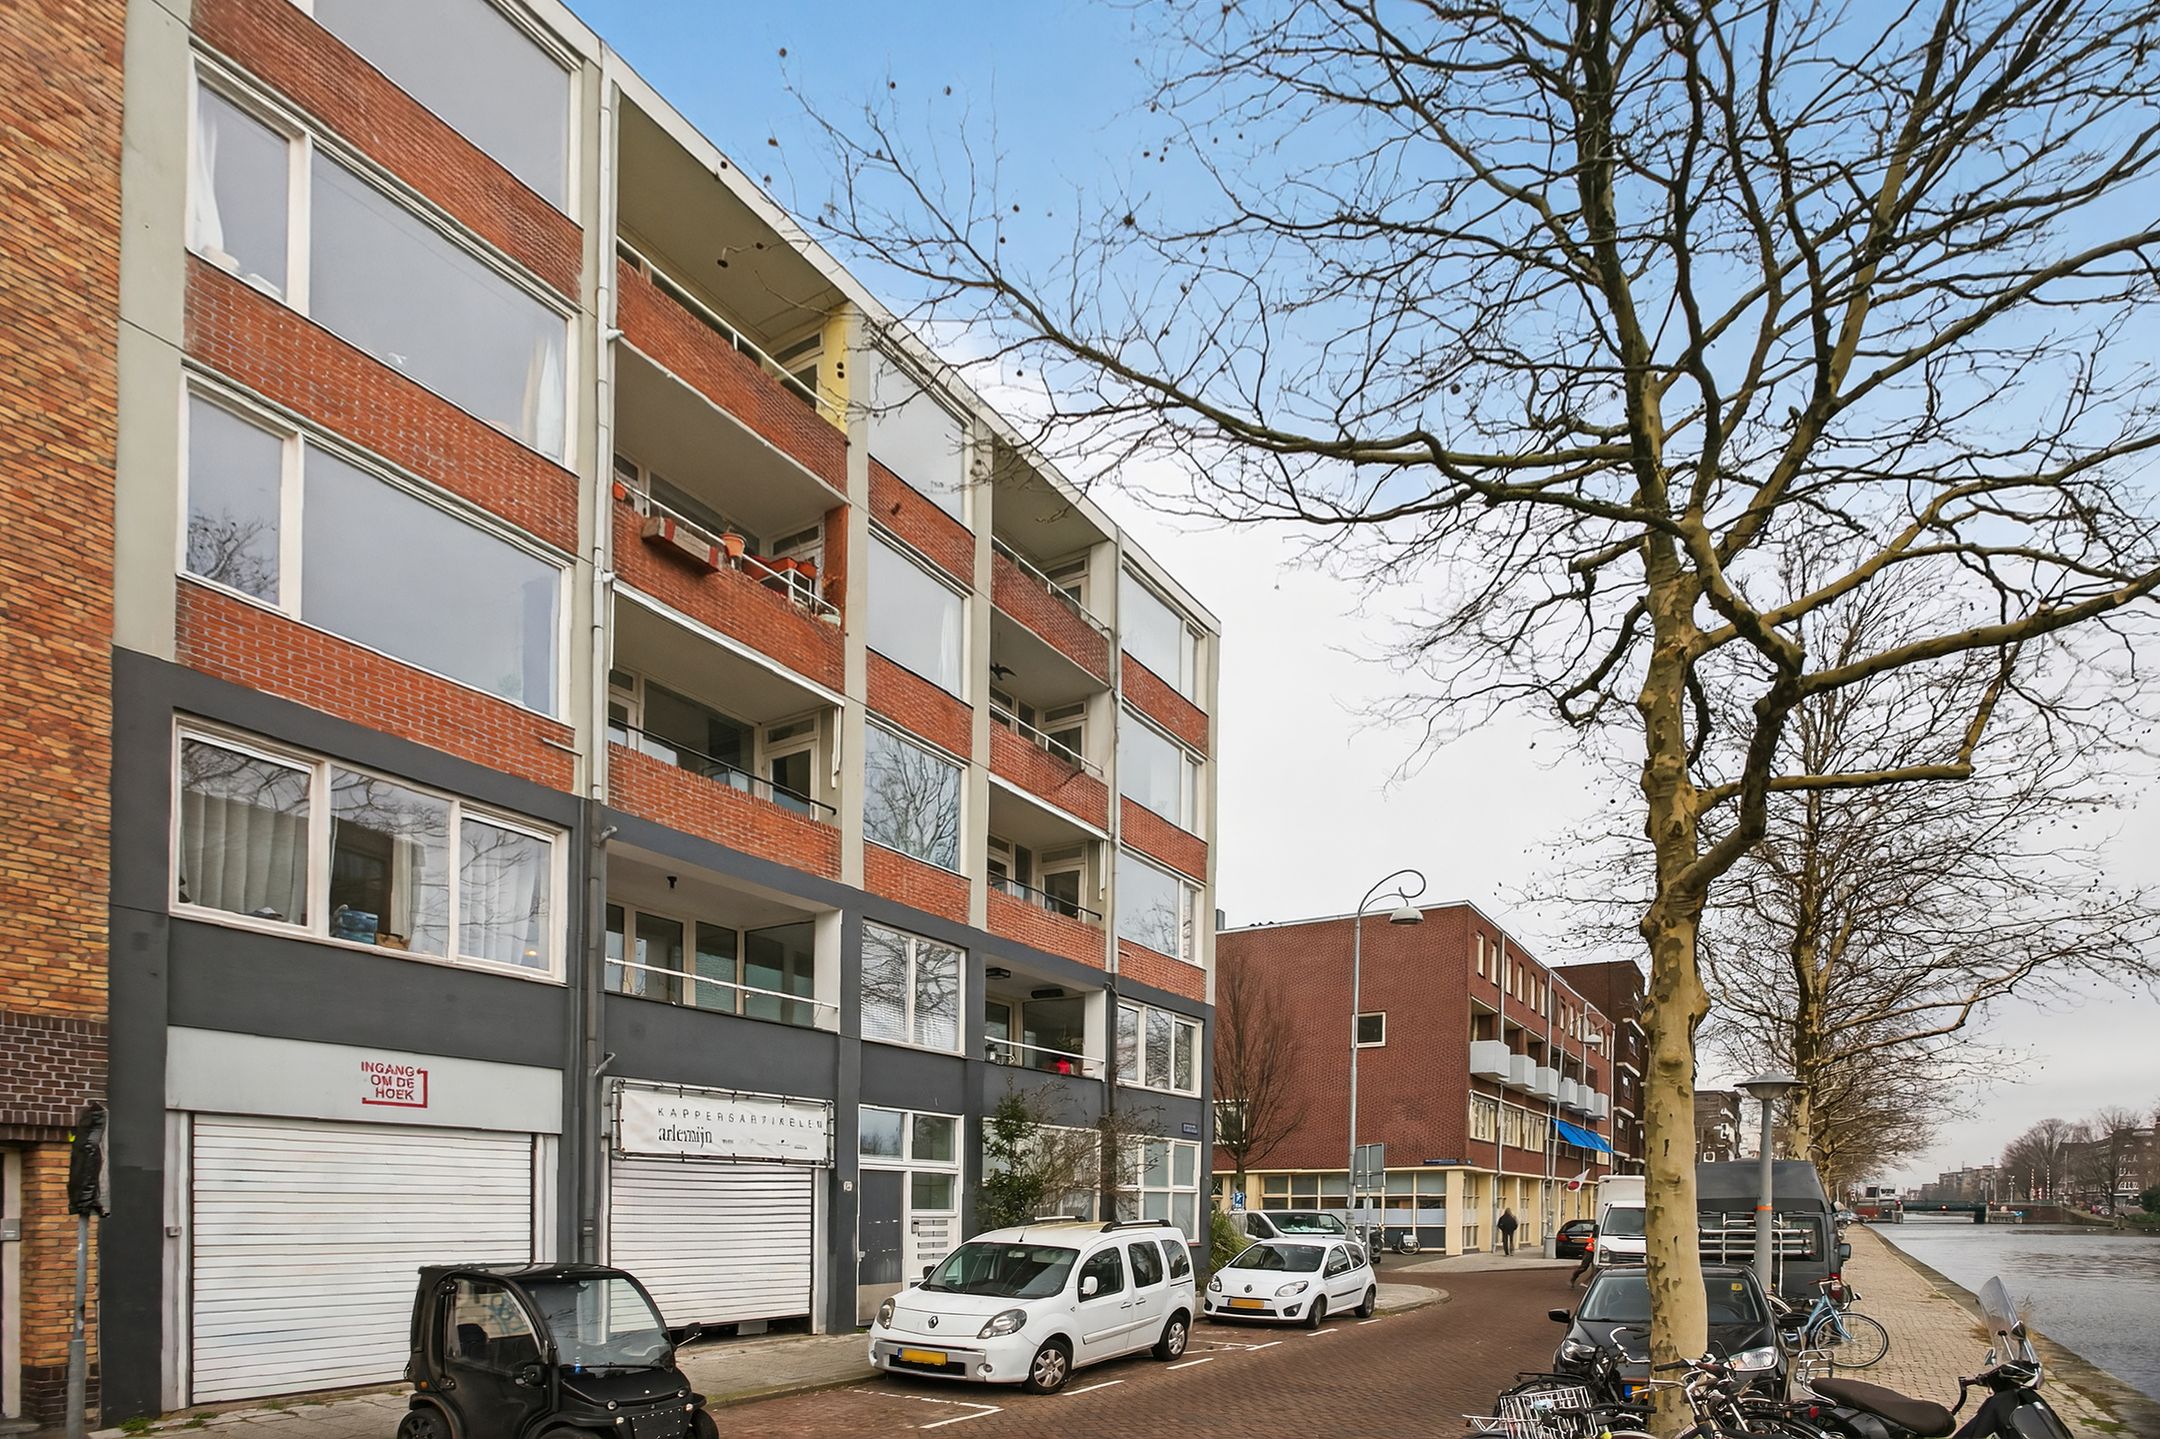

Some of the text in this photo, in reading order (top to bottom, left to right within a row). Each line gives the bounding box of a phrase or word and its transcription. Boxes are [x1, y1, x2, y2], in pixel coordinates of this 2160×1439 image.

[361, 1061, 415, 1077] INGANG
[371, 1074, 415, 1089] OM DE
[375, 1087, 414, 1101] HOEK
[657, 1107, 823, 1129] KAPPERSARTIKELEN
